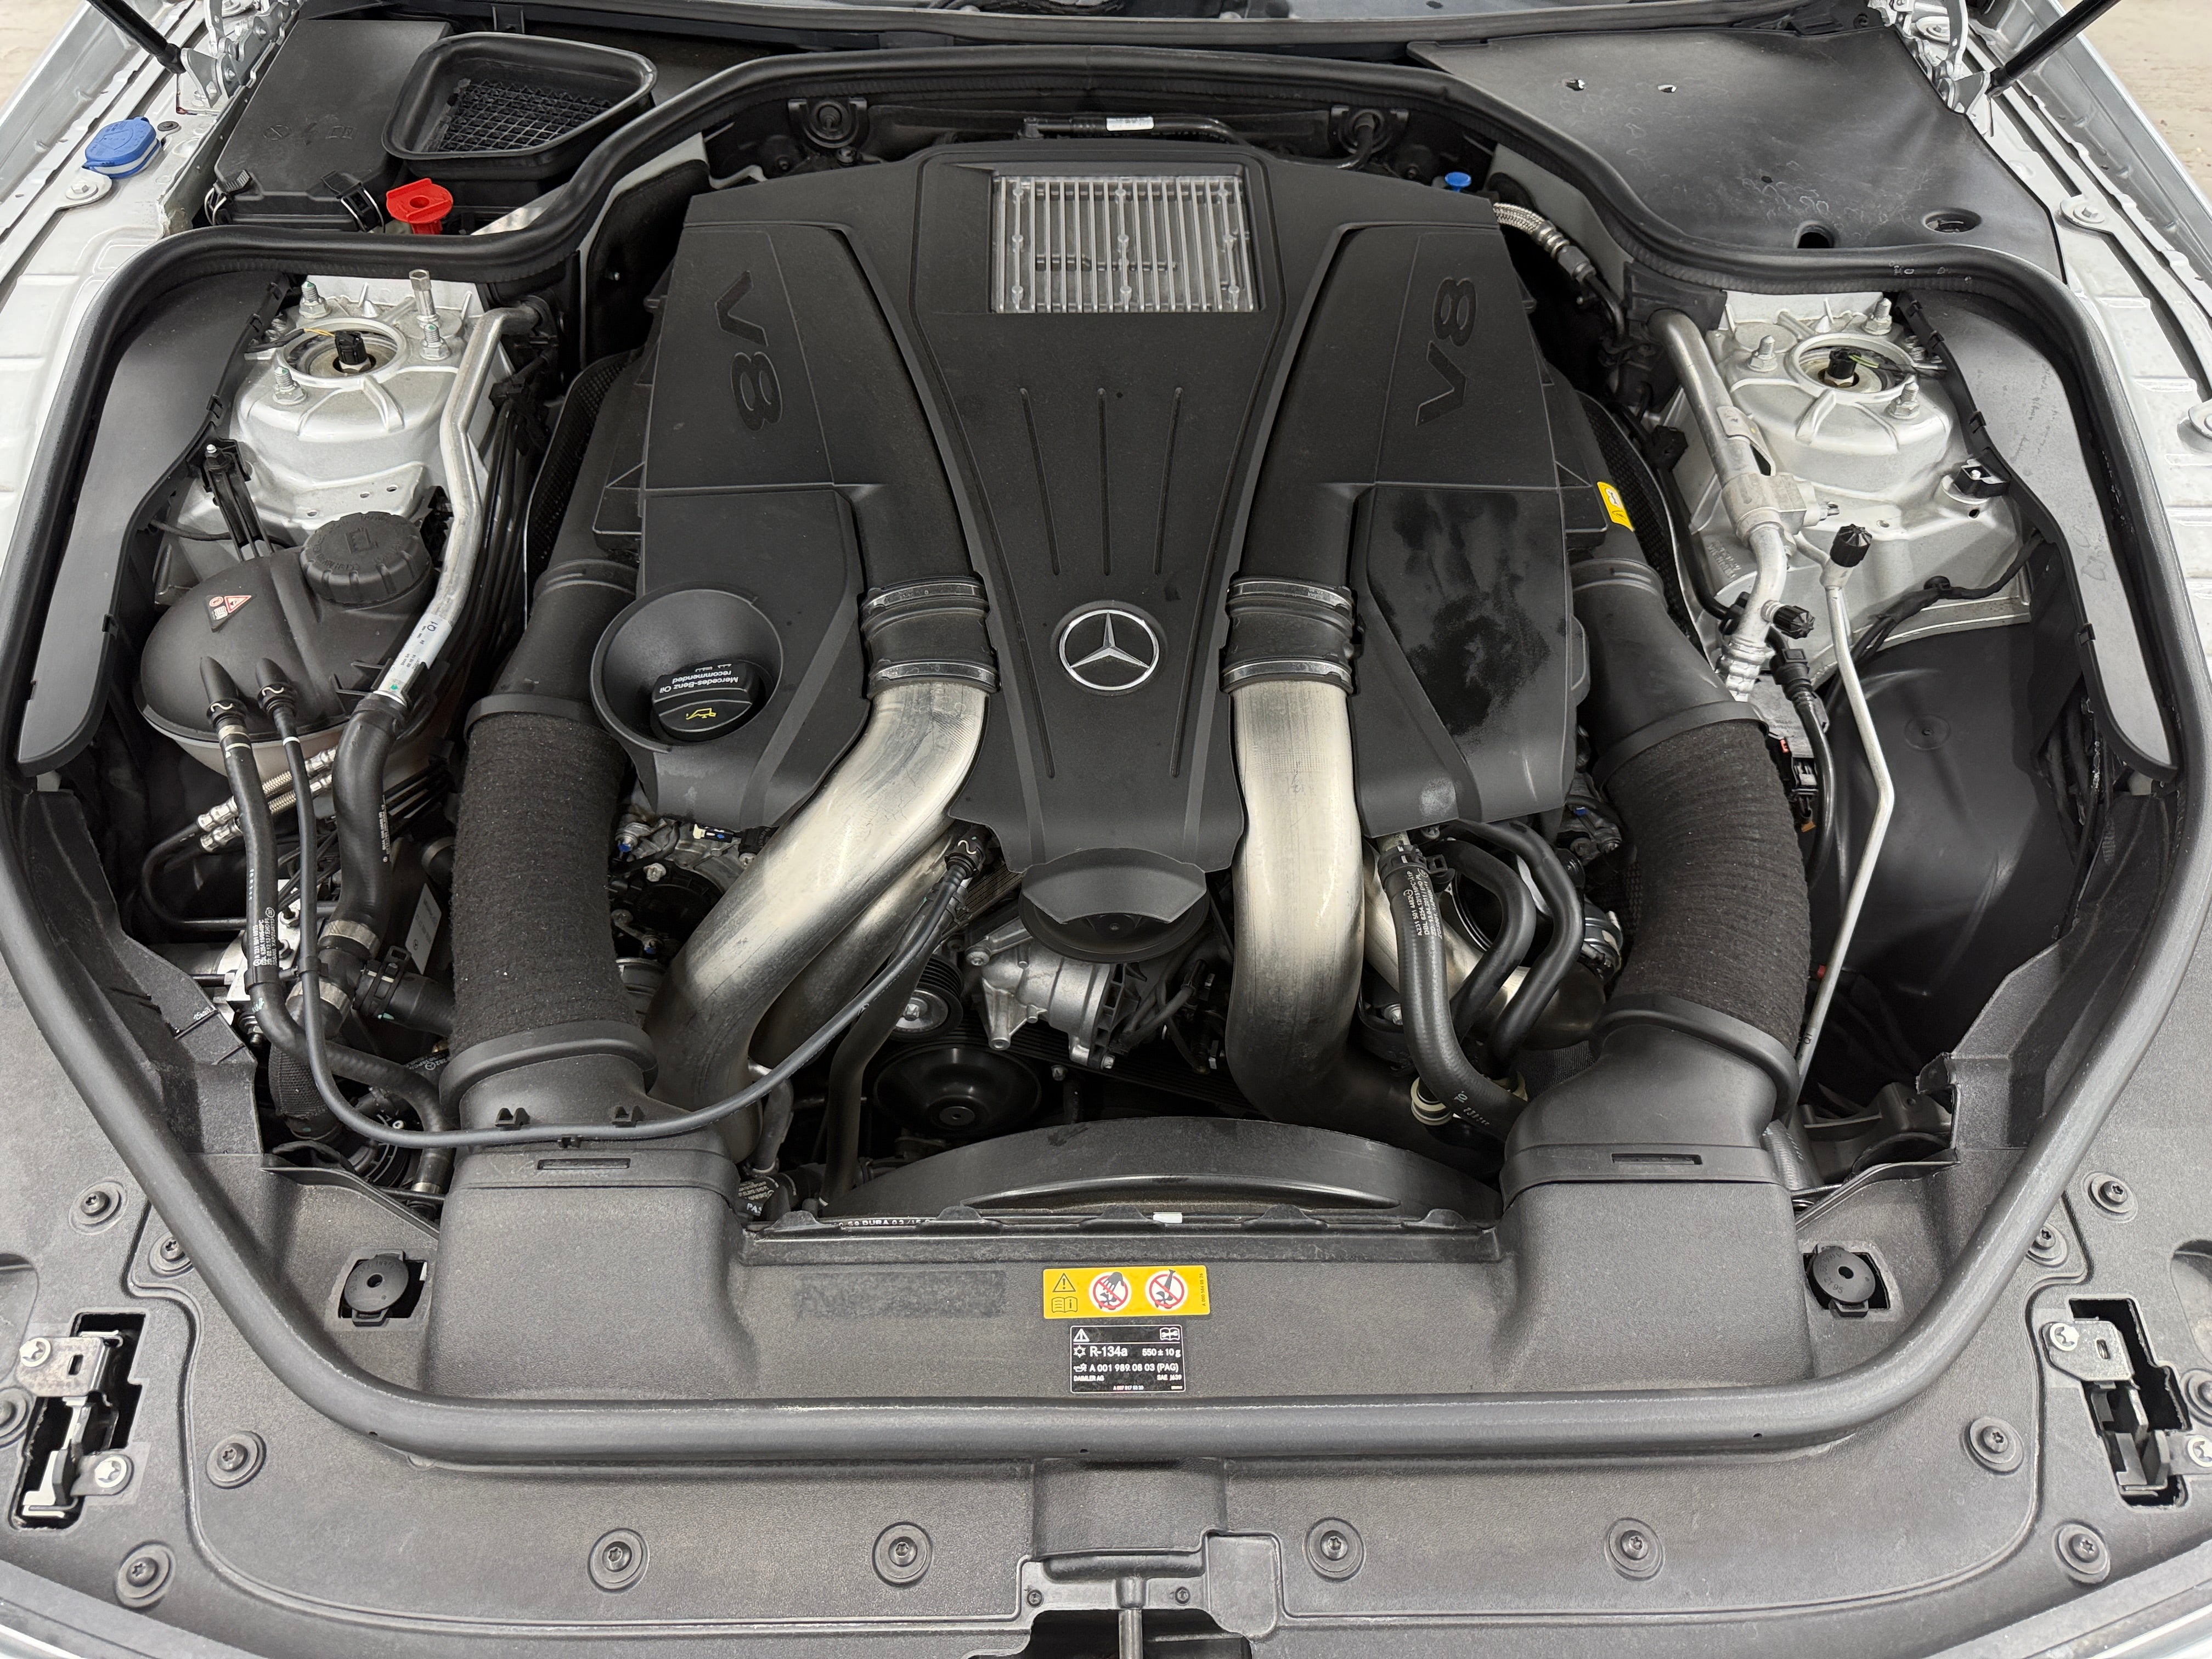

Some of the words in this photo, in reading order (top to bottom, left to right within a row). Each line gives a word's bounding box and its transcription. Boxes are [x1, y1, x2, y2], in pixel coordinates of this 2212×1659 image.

[715, 270, 783, 431] V8
[1415, 277, 1477, 426] V8
[427, 621, 438, 631] Q1
[672, 670, 732, 685] recommended
[673, 676, 739, 690] Mercedes-Benz
[1090, 1346, 1128, 1357] R-134a
[1142, 1348, 1157, 1356] 550
[1165, 1348, 1175, 1356] 10
[1175, 1350, 1181, 1358] g
[1089, 1364, 1096, 1372] A
[1097, 1364, 1113, 1372] 001
[1132, 1363, 1143, 1372] 08
[1144, 1363, 1155, 1372] 03
[1156, 1363, 1179, 1373] (PAG)
